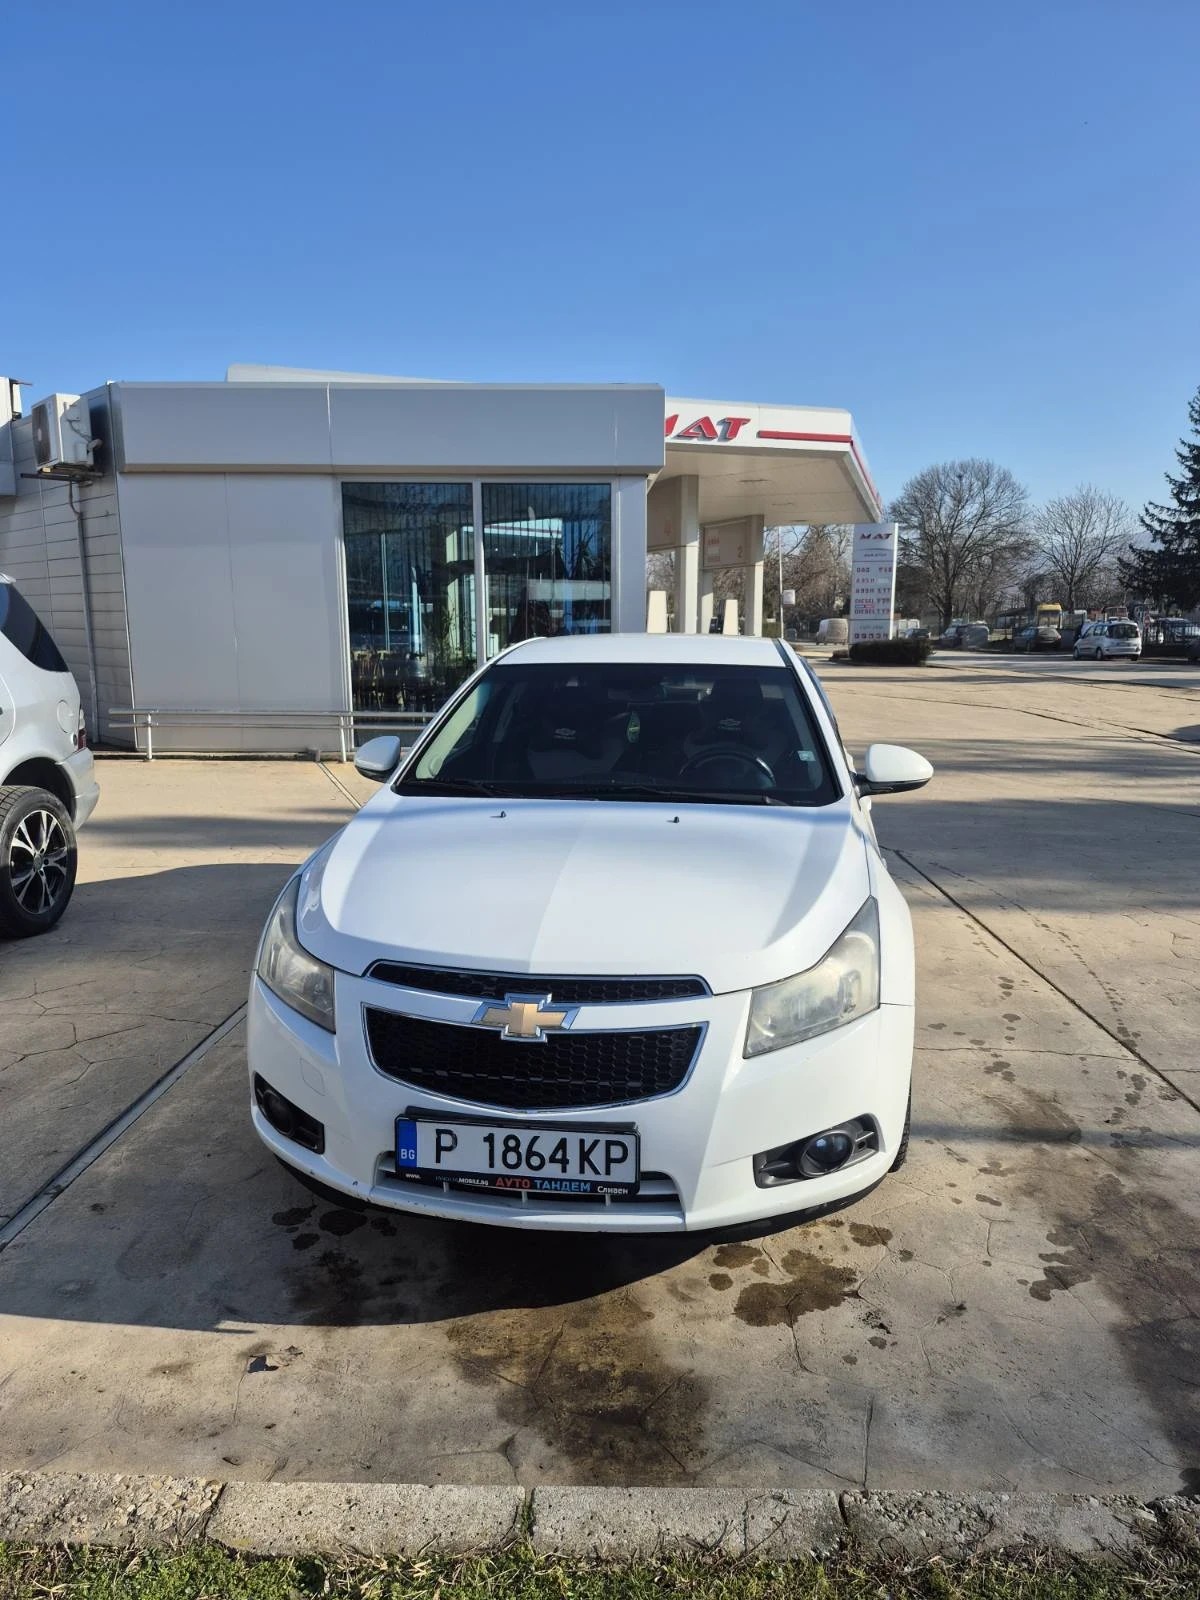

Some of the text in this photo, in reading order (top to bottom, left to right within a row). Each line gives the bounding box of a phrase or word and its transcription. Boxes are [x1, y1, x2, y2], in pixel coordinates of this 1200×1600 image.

[435, 1128, 458, 1164] P
[400, 1148, 416, 1160] BG
[495, 1177, 531, 1189] АУТО
[535, 1179, 591, 1192] ТАНДЕМ
